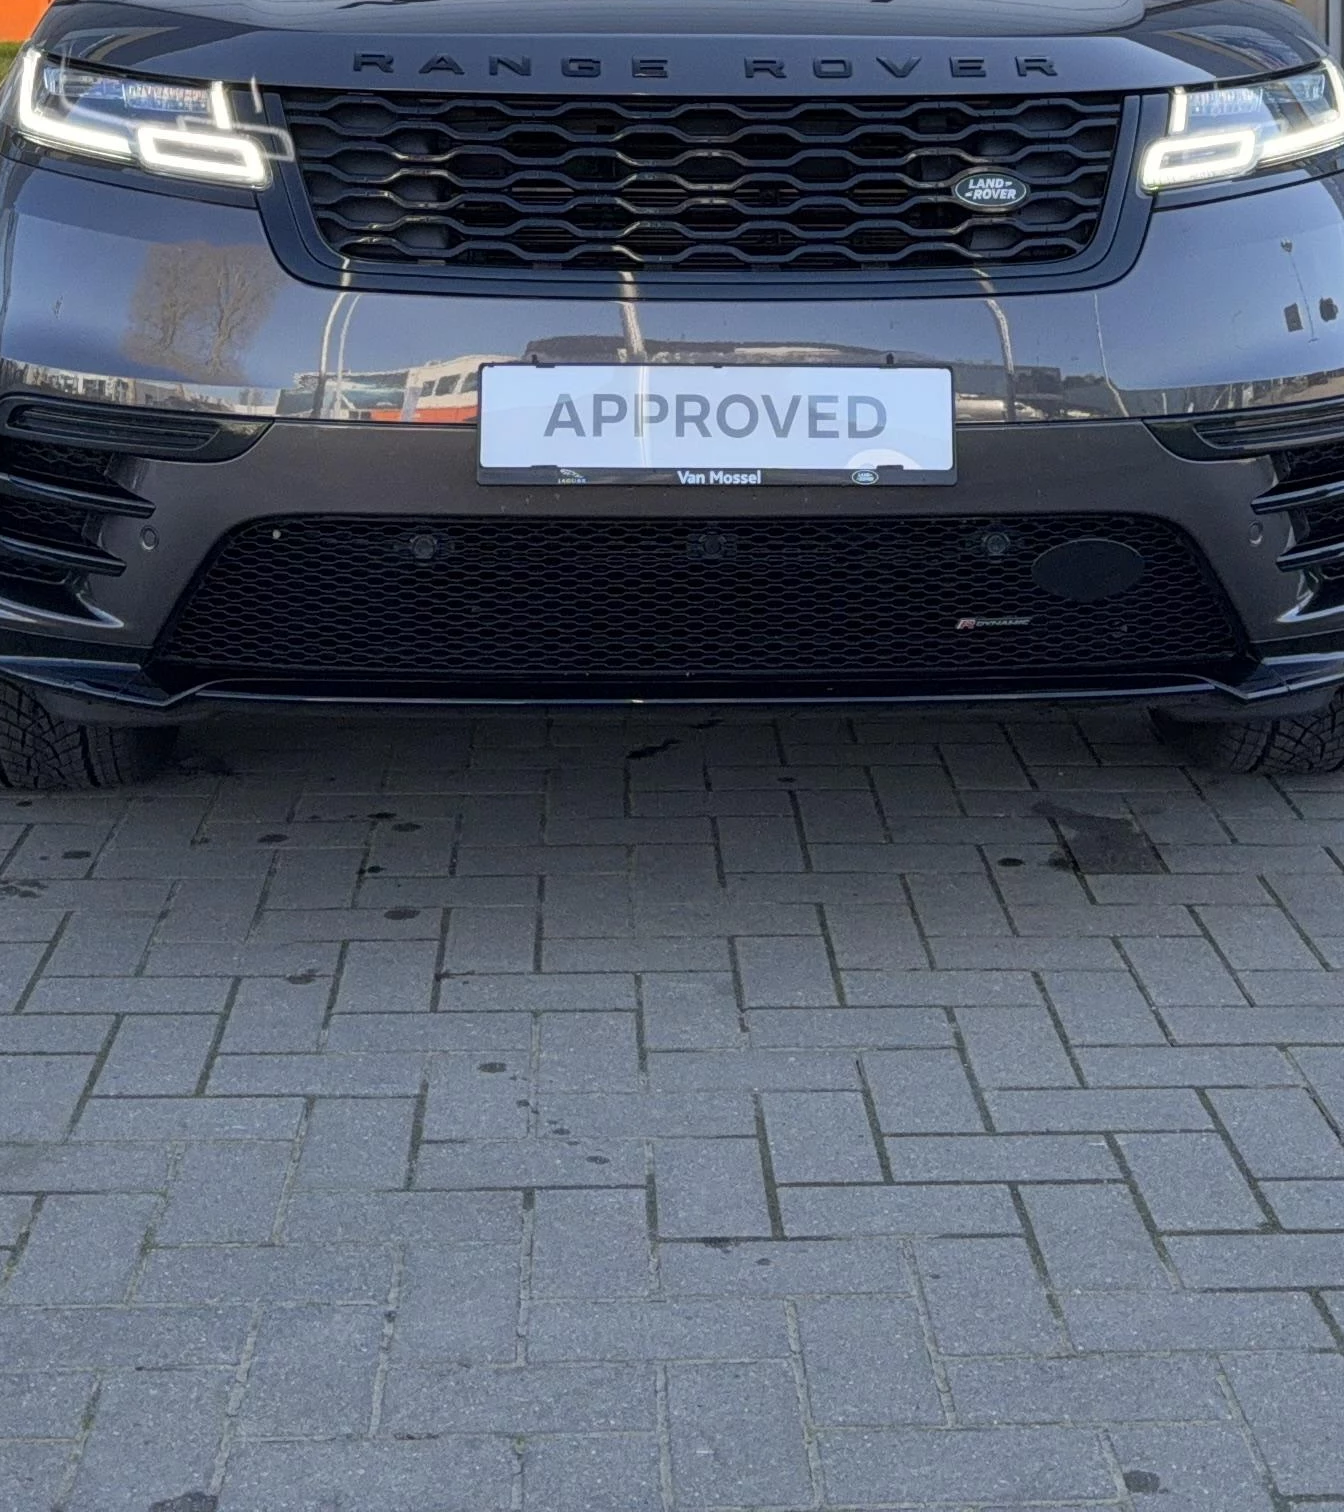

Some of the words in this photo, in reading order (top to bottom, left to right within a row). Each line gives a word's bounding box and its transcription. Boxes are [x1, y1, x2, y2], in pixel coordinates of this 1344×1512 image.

[353, 52, 668, 78] RANGE
[743, 55, 1058, 79] ROVER
[968, 178, 1004, 189] LAND
[972, 189, 1017, 200] ROVER
[543, 393, 887, 439] APPROVED
[677, 470, 706, 484] Van
[709, 469, 761, 485] Mossel
